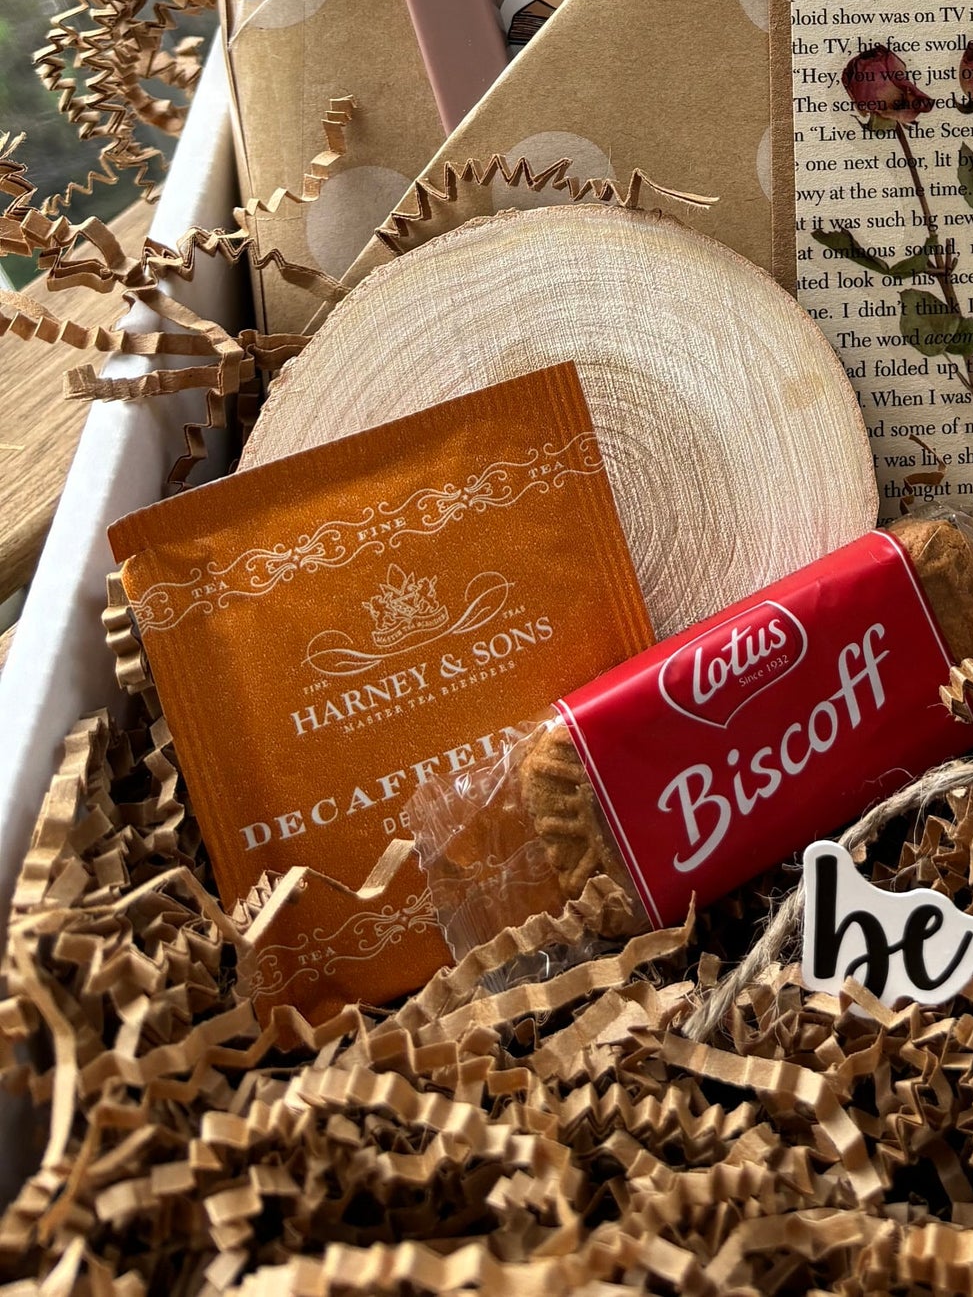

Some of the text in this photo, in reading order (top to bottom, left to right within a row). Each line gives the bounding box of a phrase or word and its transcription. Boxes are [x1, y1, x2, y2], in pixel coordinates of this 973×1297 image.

[833, 8, 876, 24] show
[879, 13, 910, 23] was
[914, 12, 935, 22] on
[939, 7, 965, 22] TV
[793, 36, 920, 55] the TV, face
[880, 70, 921, 85] were
[926, 66, 956, 86] just
[795, 97, 827, 112] The
[833, 96, 887, 111] screen
[908, 124, 935, 139] the
[806, 160, 837, 171] one
[844, 156, 879, 170] next
[886, 152, 928, 170] door,
[935, 151, 951, 167] lit
[830, 186, 845, 200] at
[850, 182, 877, 199] the
[882, 186, 924, 199] same
[930, 182, 972, 196] time.
[813, 216, 824, 230] it
[830, 217, 860, 229] was
[867, 211, 906, 228] such
[912, 209, 938, 231] big
[837, 271, 873, 288] look
[842, 303, 849, 318] I
[916, 300, 960, 315] think
[837, 331, 871, 348] The
[876, 330, 920, 347] word
[874, 358, 929, 377] folded
[937, 363, 958, 380] up
[871, 389, 971, 407] When I was
[891, 417, 960, 436] some of
[528, 460, 565, 480] TEA
[357, 516, 407, 542] FINE
[191, 580, 230, 600] TEA
[692, 616, 788, 705] Lotus
[290, 662, 430, 736] HARNEY
[440, 653, 468, 679] &
[472, 616, 554, 666] SONS
[738, 654, 790, 688] Since 1932
[343, 660, 516, 734] MASTER TEA BLENDERS
[657, 622, 890, 873] Biscoff
[298, 946, 336, 966] TEA
